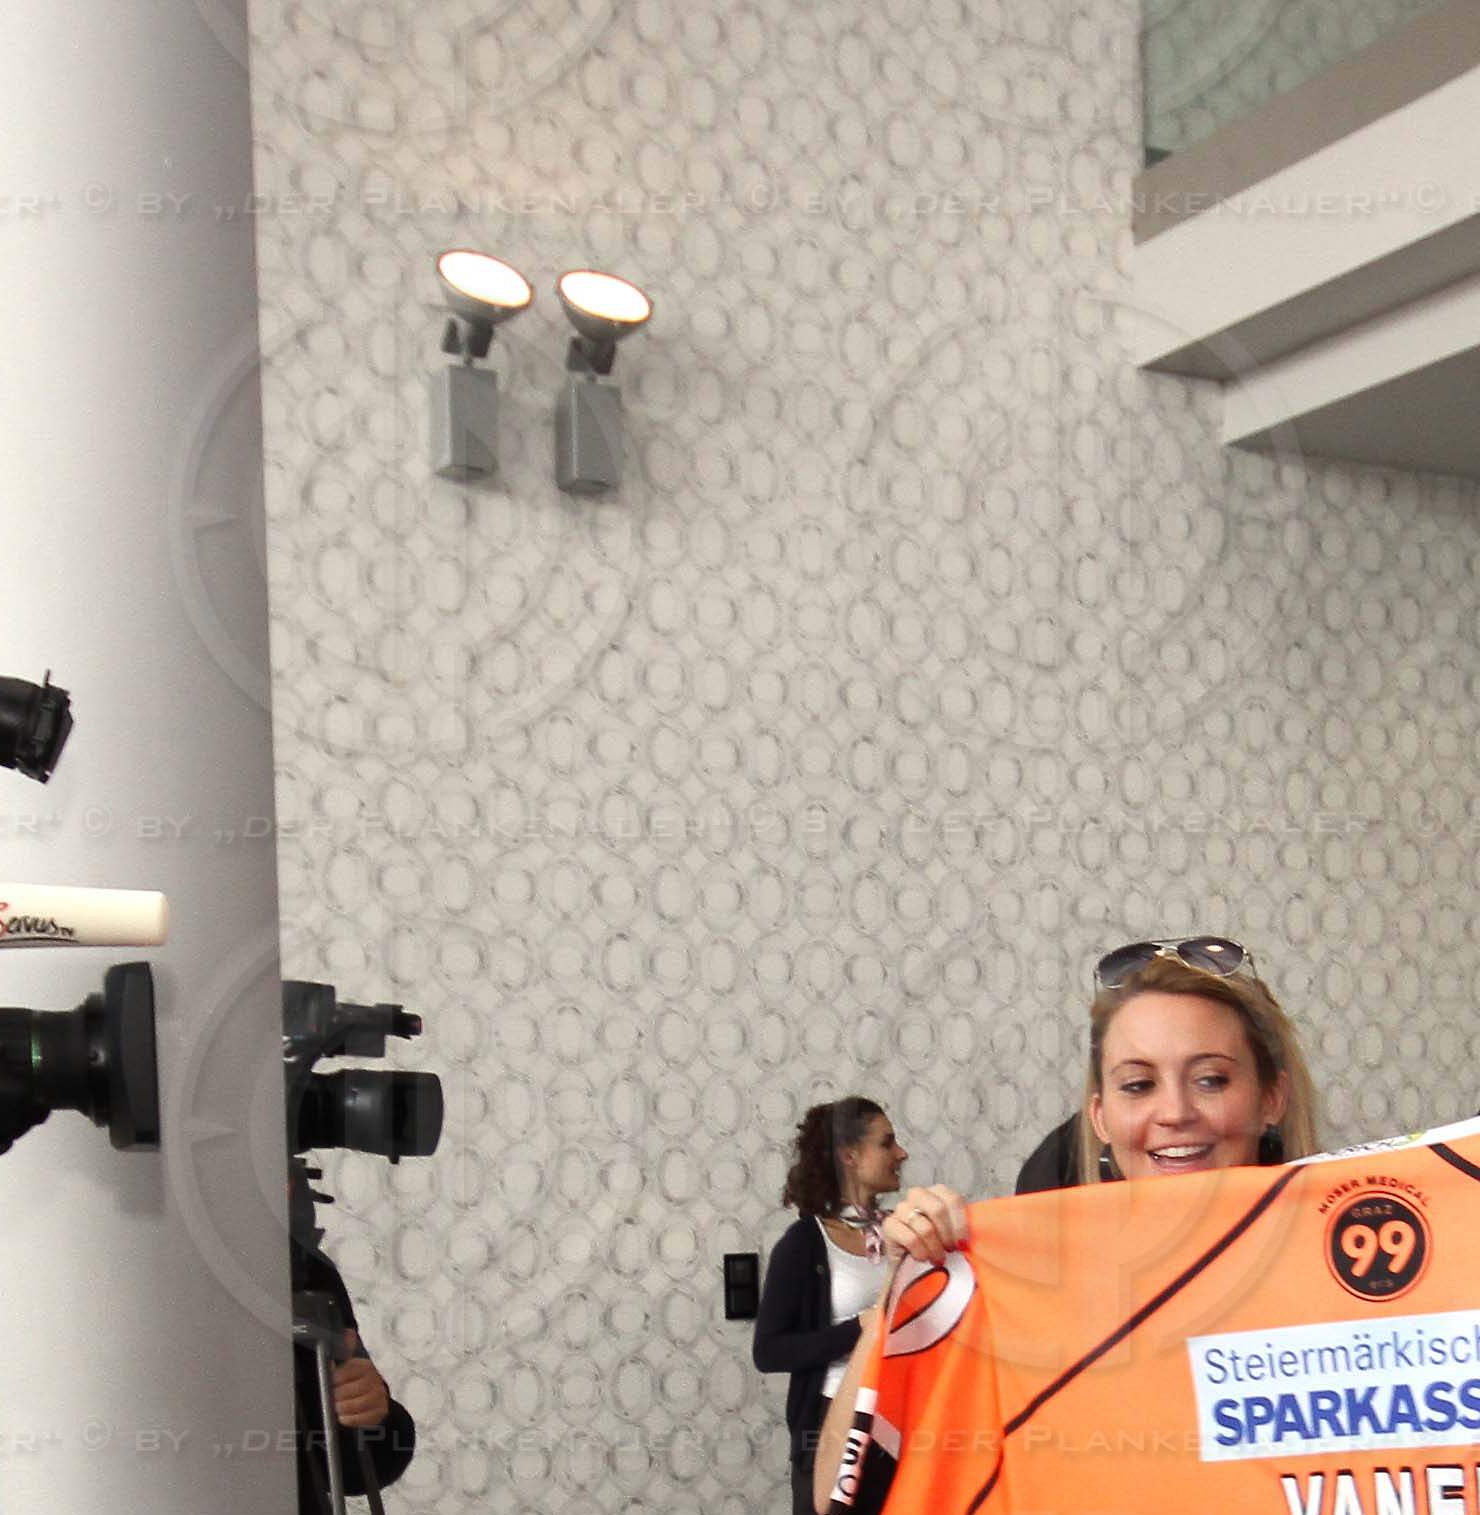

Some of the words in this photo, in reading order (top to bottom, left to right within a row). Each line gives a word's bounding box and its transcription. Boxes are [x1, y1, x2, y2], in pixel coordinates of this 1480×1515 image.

[1318, 1179, 1361, 1215] MOSER
[1366, 1175, 1432, 1208] MEDICAL
[1340, 1219, 1417, 1278] 99
